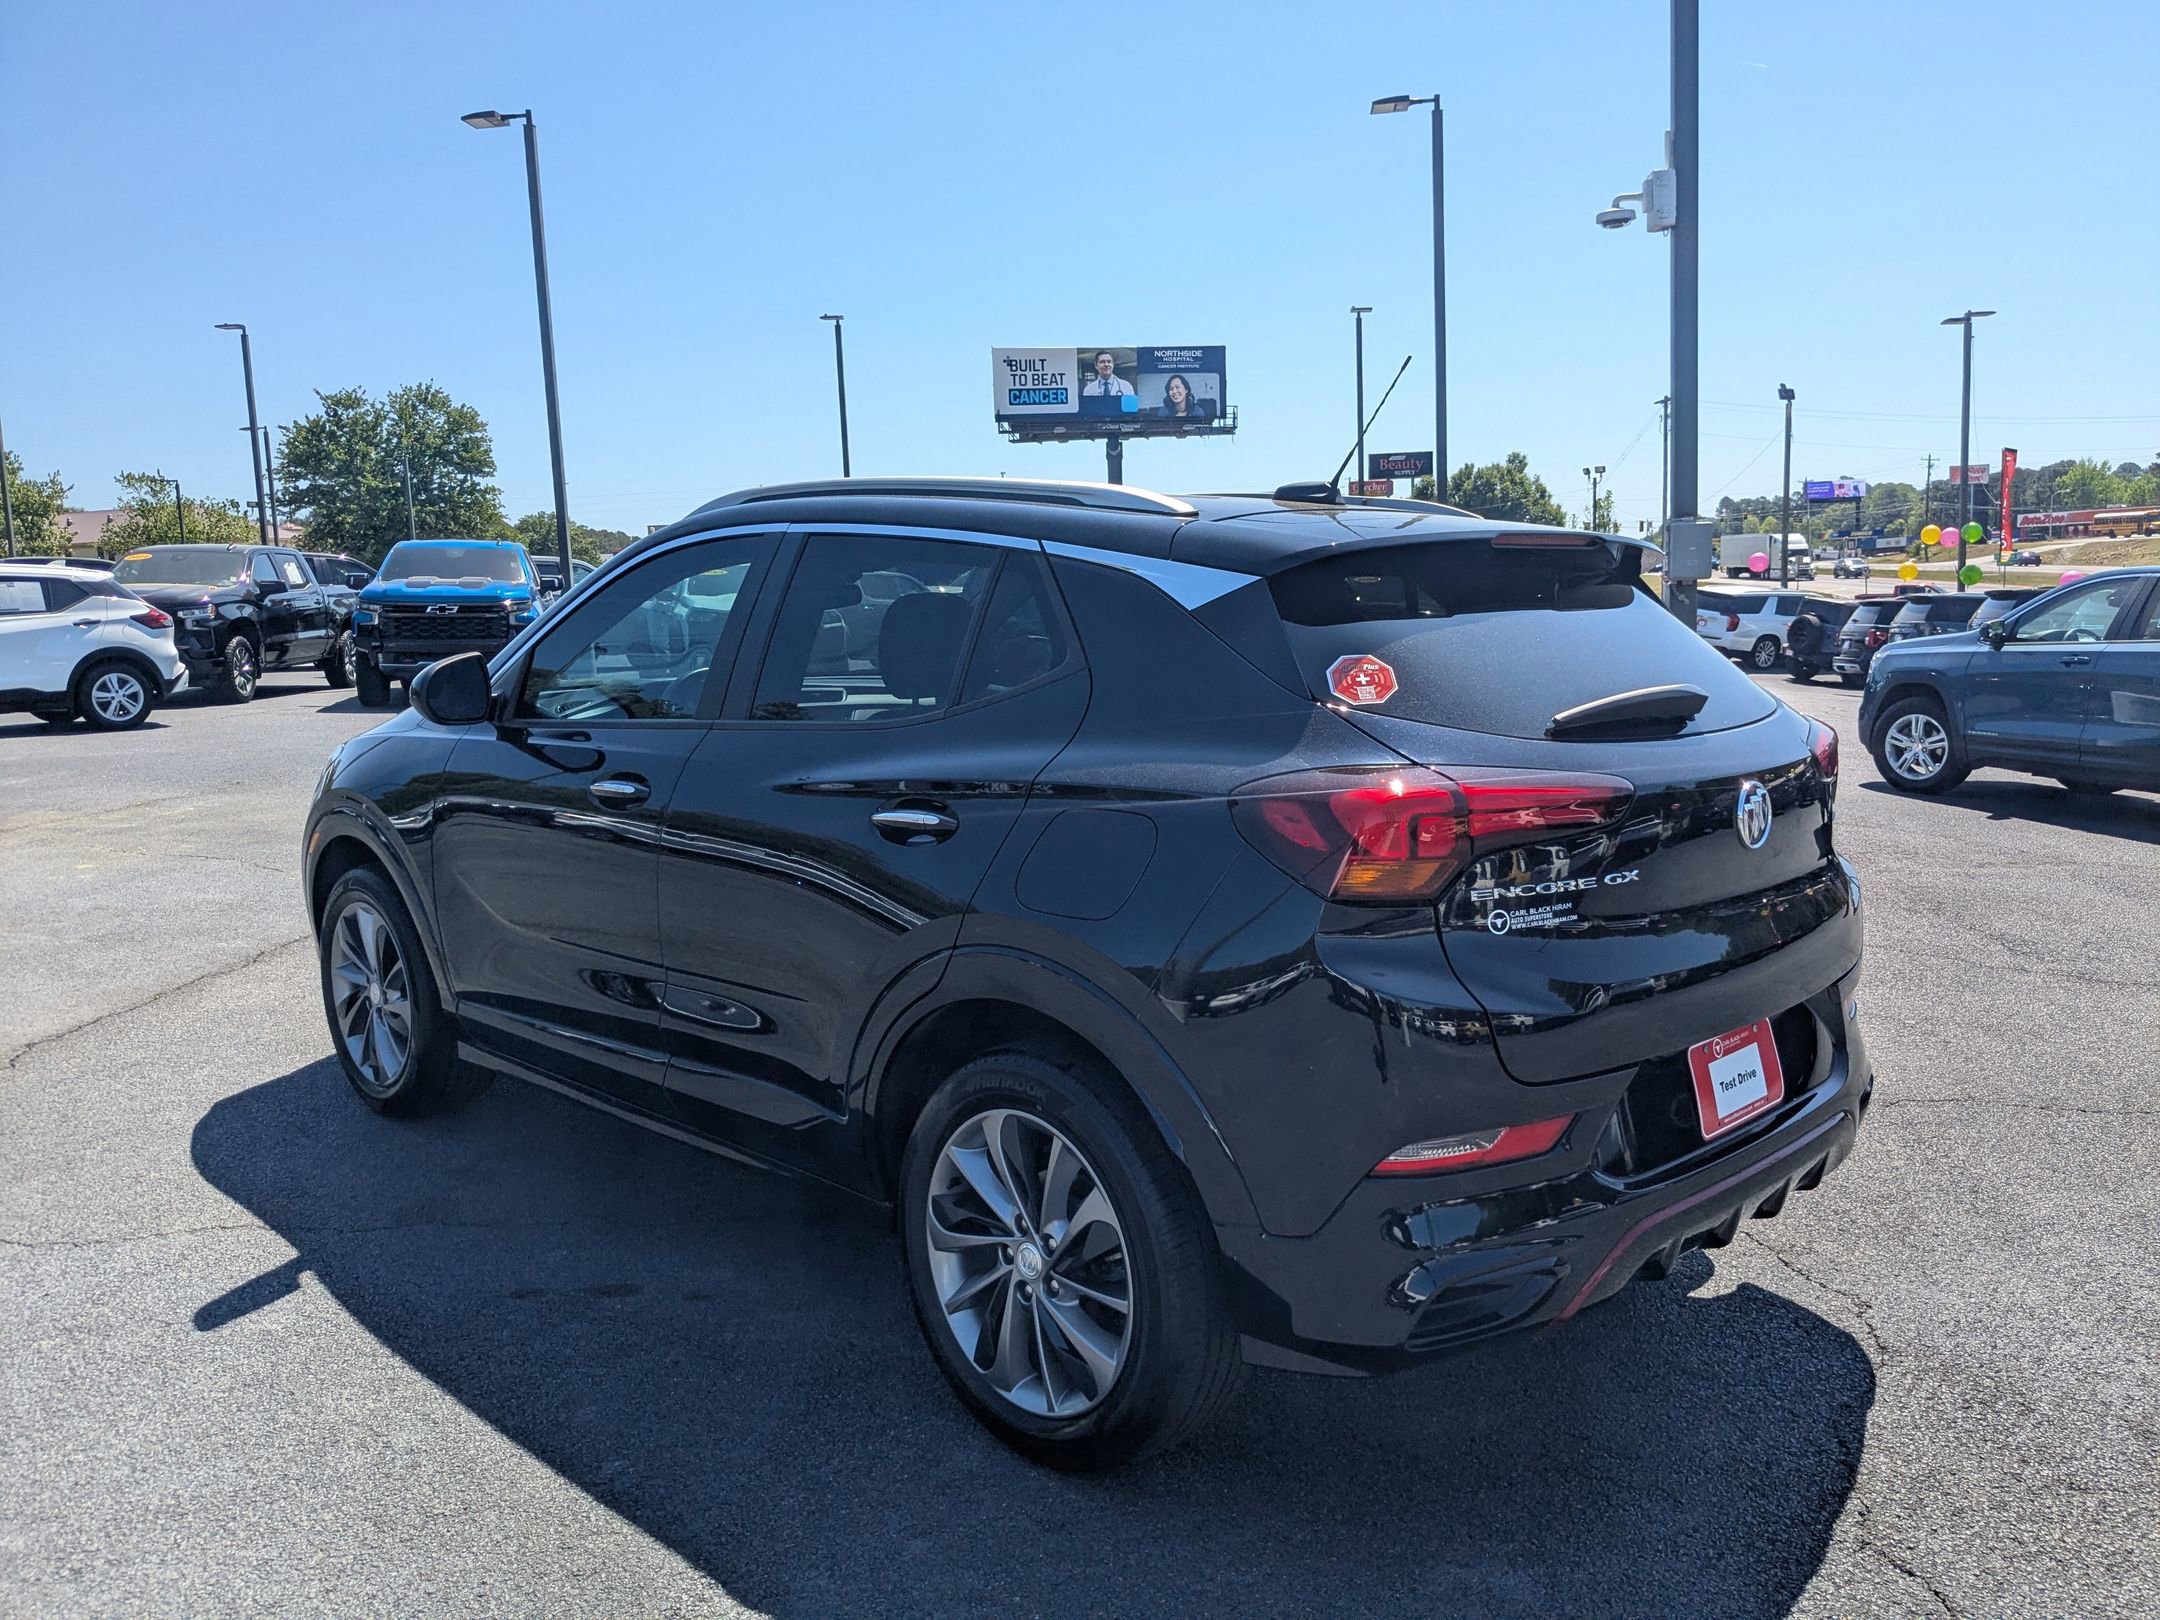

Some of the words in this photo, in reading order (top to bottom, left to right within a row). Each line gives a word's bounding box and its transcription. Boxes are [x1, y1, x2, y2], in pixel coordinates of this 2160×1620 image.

[1154, 350, 1203, 358] NORTHSIDE
[1010, 358, 1047, 372] BUILT
[1010, 373, 1027, 387] TO
[1032, 372, 1066, 386] BEAT
[1010, 389, 1067, 404] CANCER
[1379, 458, 1424, 472] Beauty
[1470, 877, 1598, 901] ENCORE
[1603, 869, 1640, 885] GX
[1510, 909, 1529, 917] CARL
[1530, 906, 1551, 914] BLACK
[1552, 902, 1572, 911] HIRAM
[1525, 912, 1553, 921] SUPERSTORE
[1719, 1076, 1737, 1093] Test
[1737, 1069, 1757, 1085] Drive
